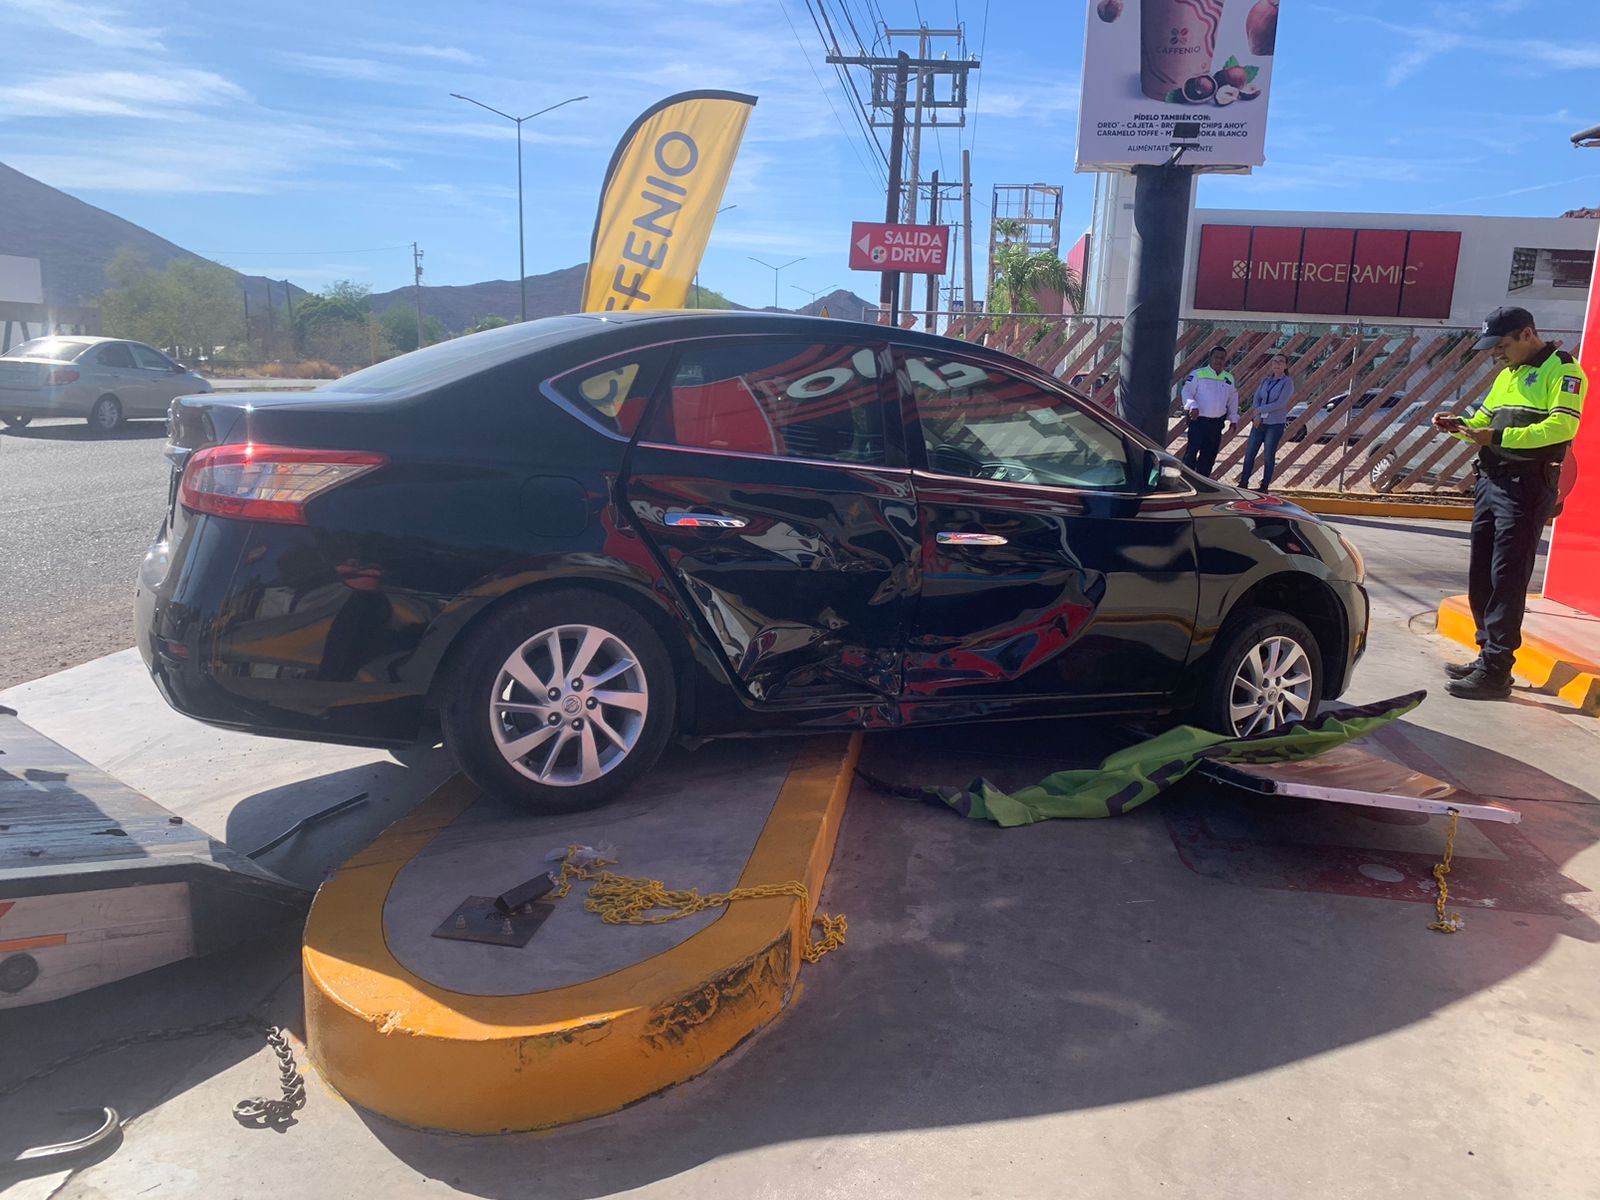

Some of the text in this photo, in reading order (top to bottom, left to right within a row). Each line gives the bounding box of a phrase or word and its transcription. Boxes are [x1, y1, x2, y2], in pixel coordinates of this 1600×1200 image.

[1134, 113, 1159, 121] PÍDELO
[1160, 113, 1191, 121] TAMBIÉN
[604, 131, 699, 310] FENIO
[884, 230, 942, 247] SALIDA
[891, 246, 942, 264] DRIVE
